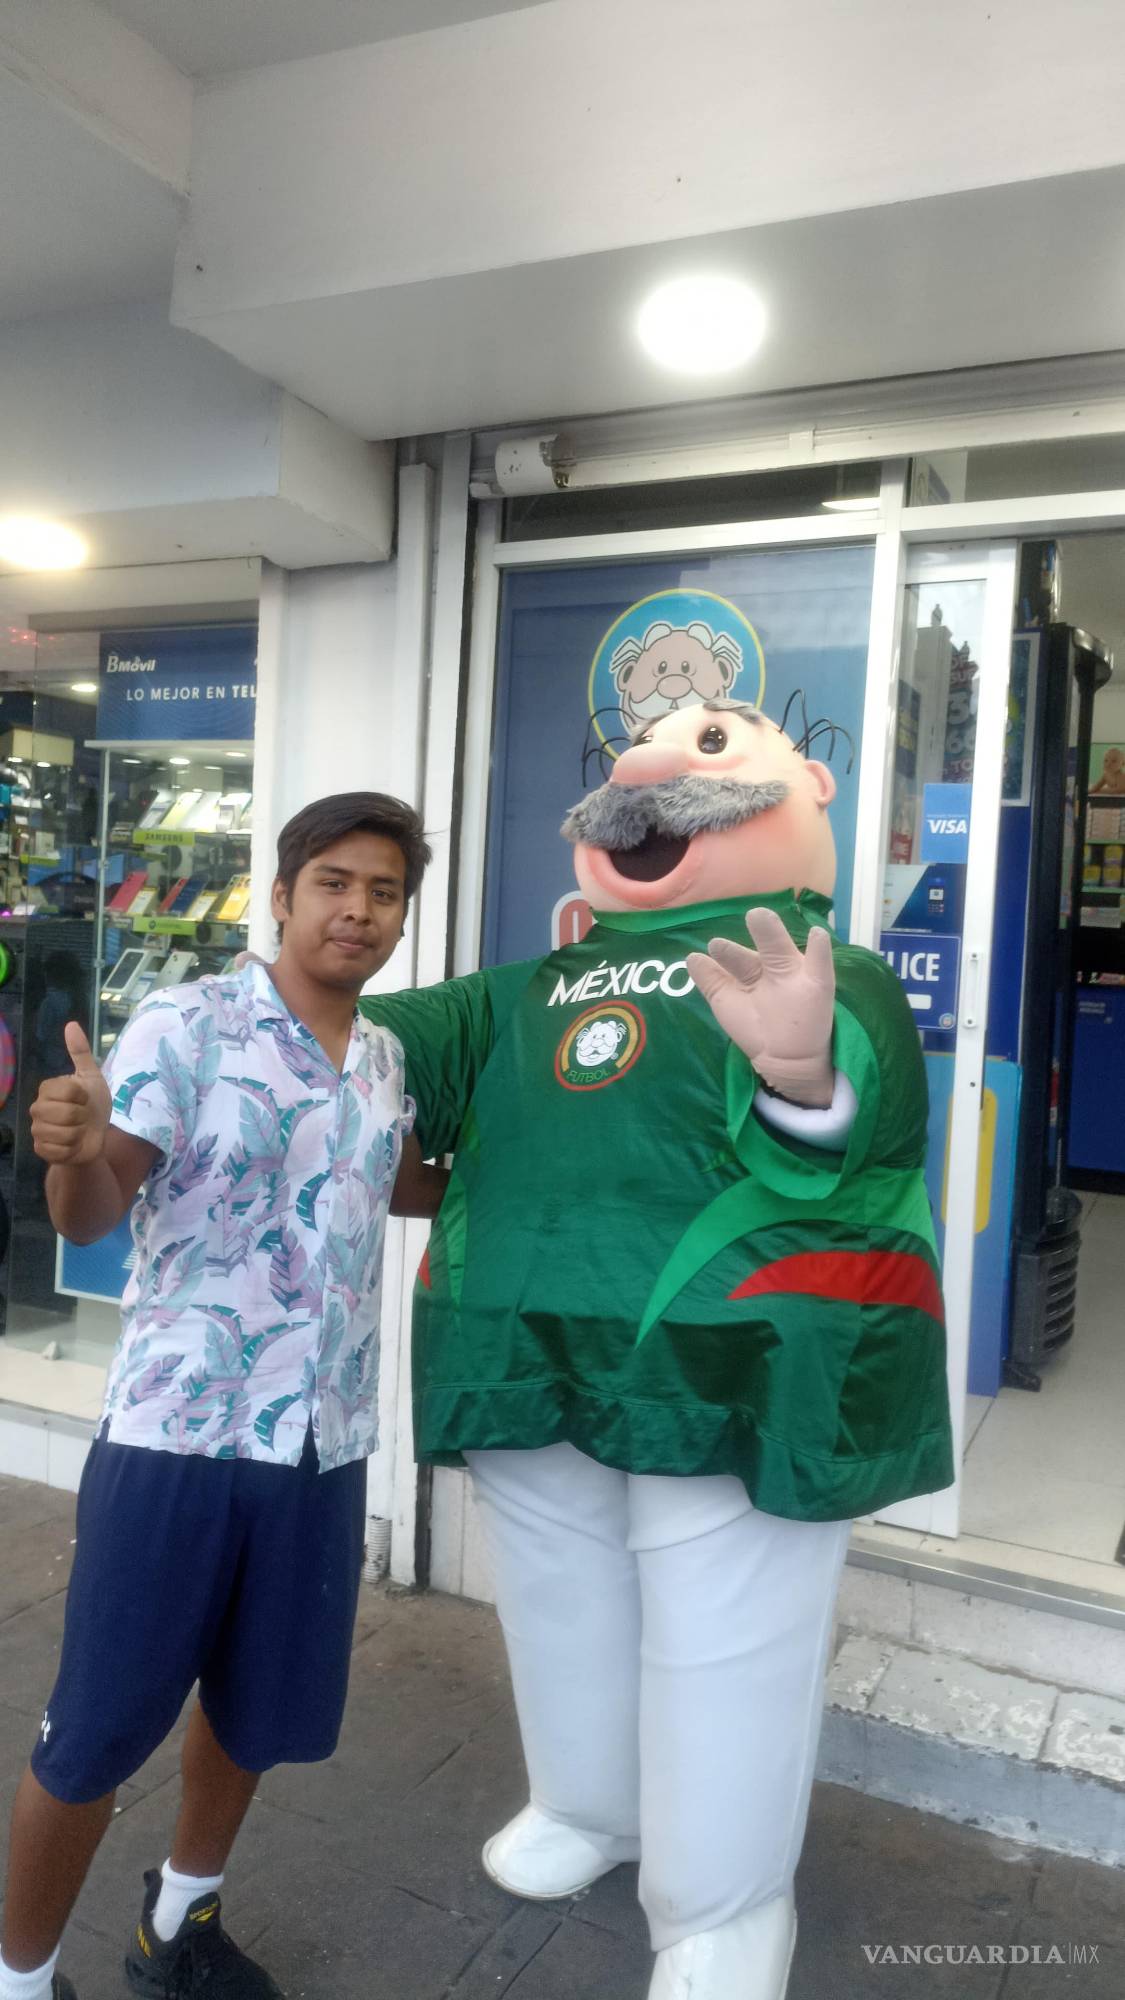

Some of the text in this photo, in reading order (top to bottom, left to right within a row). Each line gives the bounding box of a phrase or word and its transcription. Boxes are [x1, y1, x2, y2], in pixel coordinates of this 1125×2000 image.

[126, 688, 145, 701] LO
[151, 687, 200, 700] MEJOR
[206, 686, 226, 699] EN
[927, 819, 968, 834] VISA
[547, 959, 697, 1007] MÉXICO
